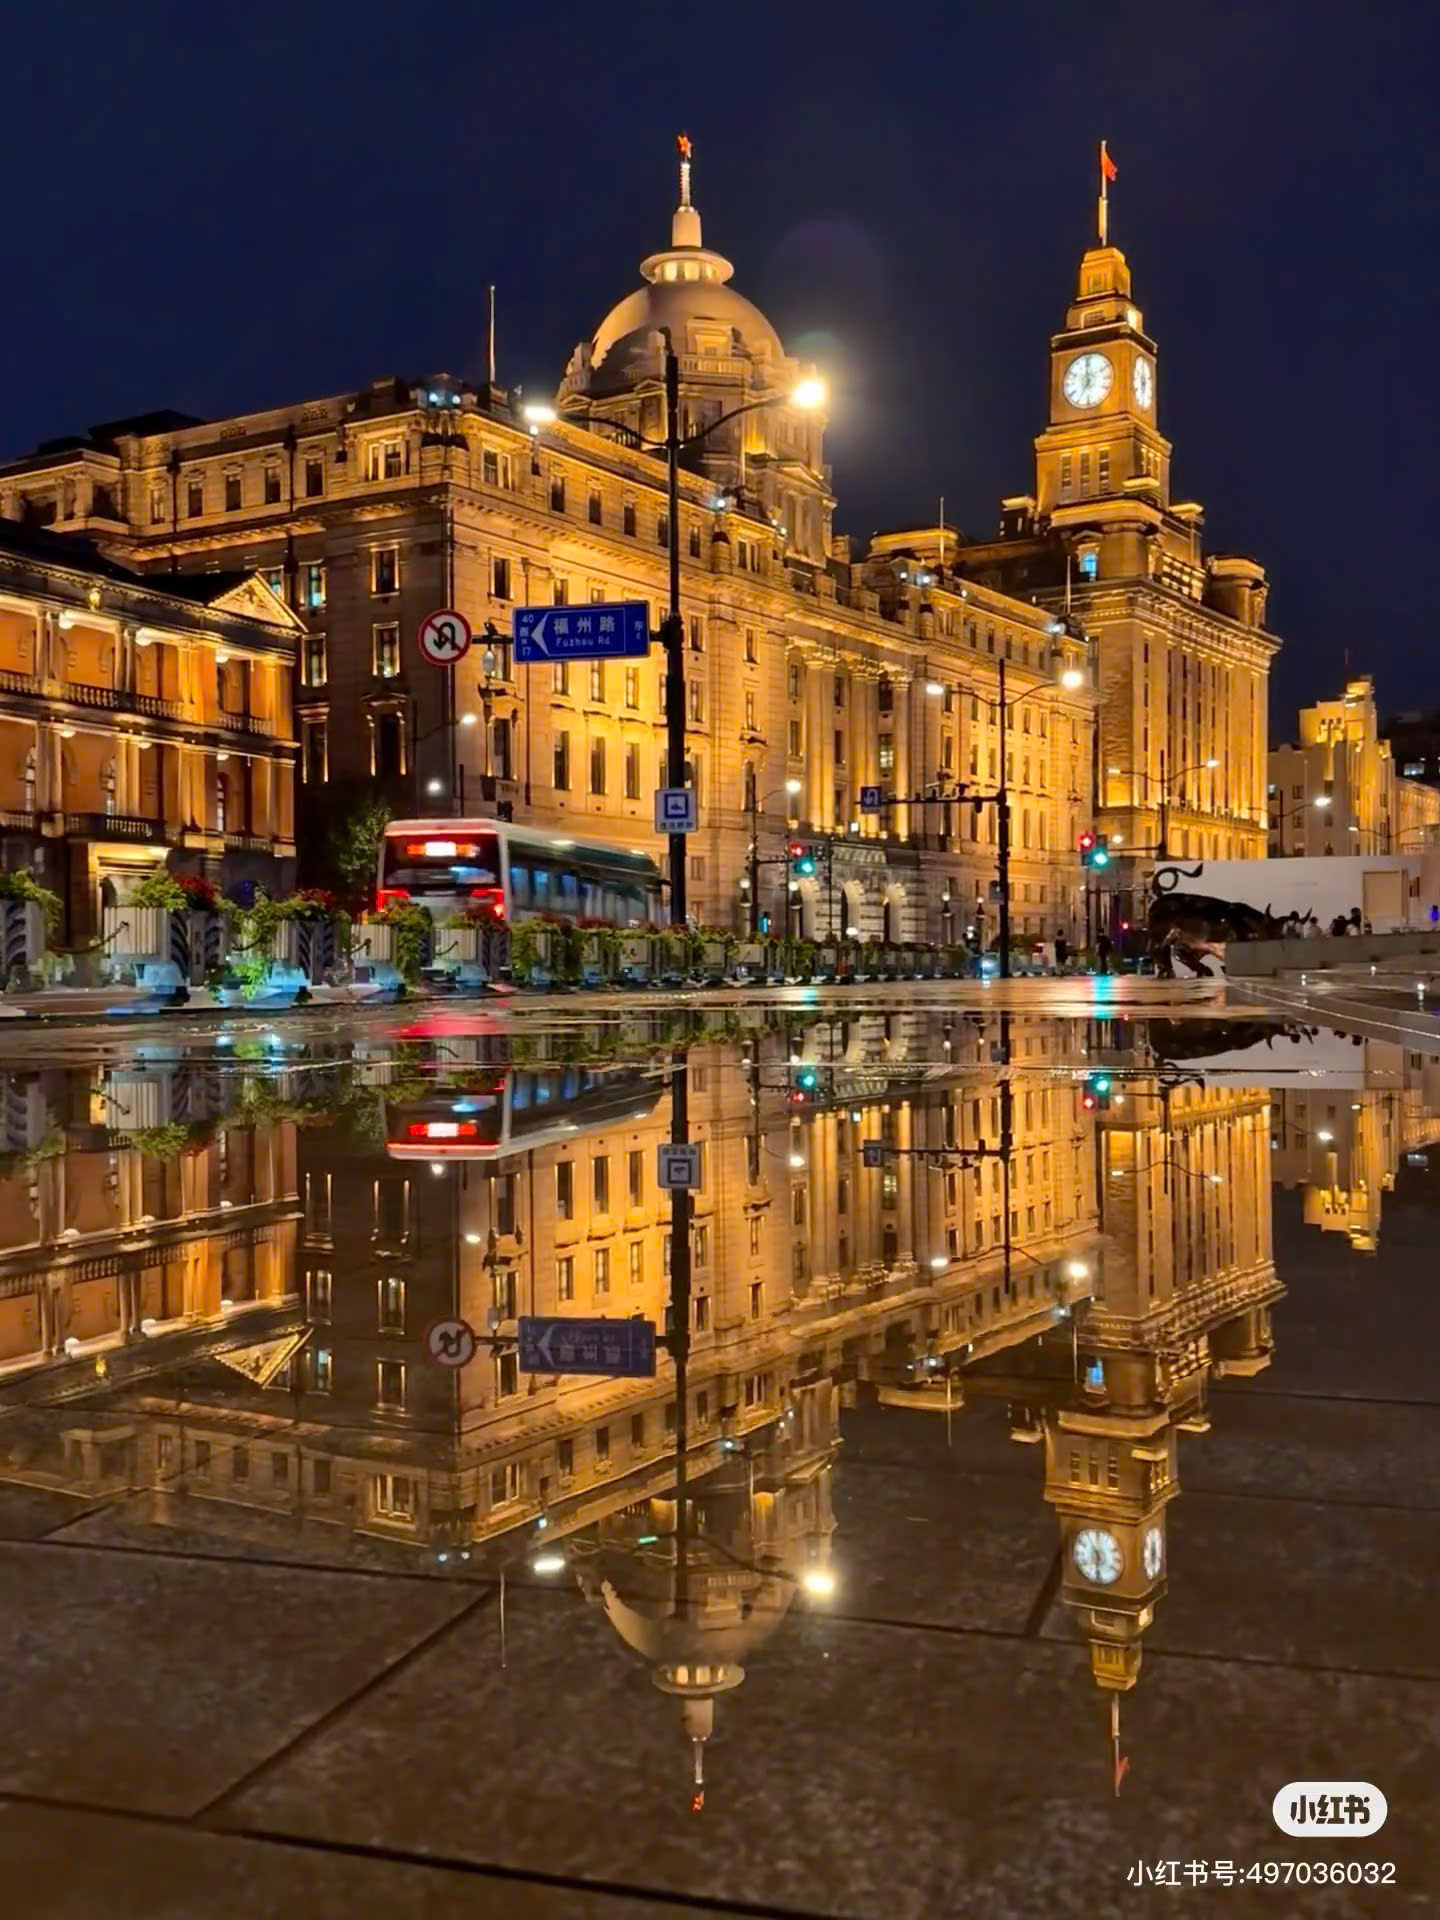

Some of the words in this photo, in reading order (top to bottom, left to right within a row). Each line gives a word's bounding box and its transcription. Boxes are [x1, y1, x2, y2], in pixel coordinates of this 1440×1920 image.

[553, 615, 615, 635] 福州路
[556, 637, 594, 648] Fuzhou
[598, 635, 610, 645] Rd
